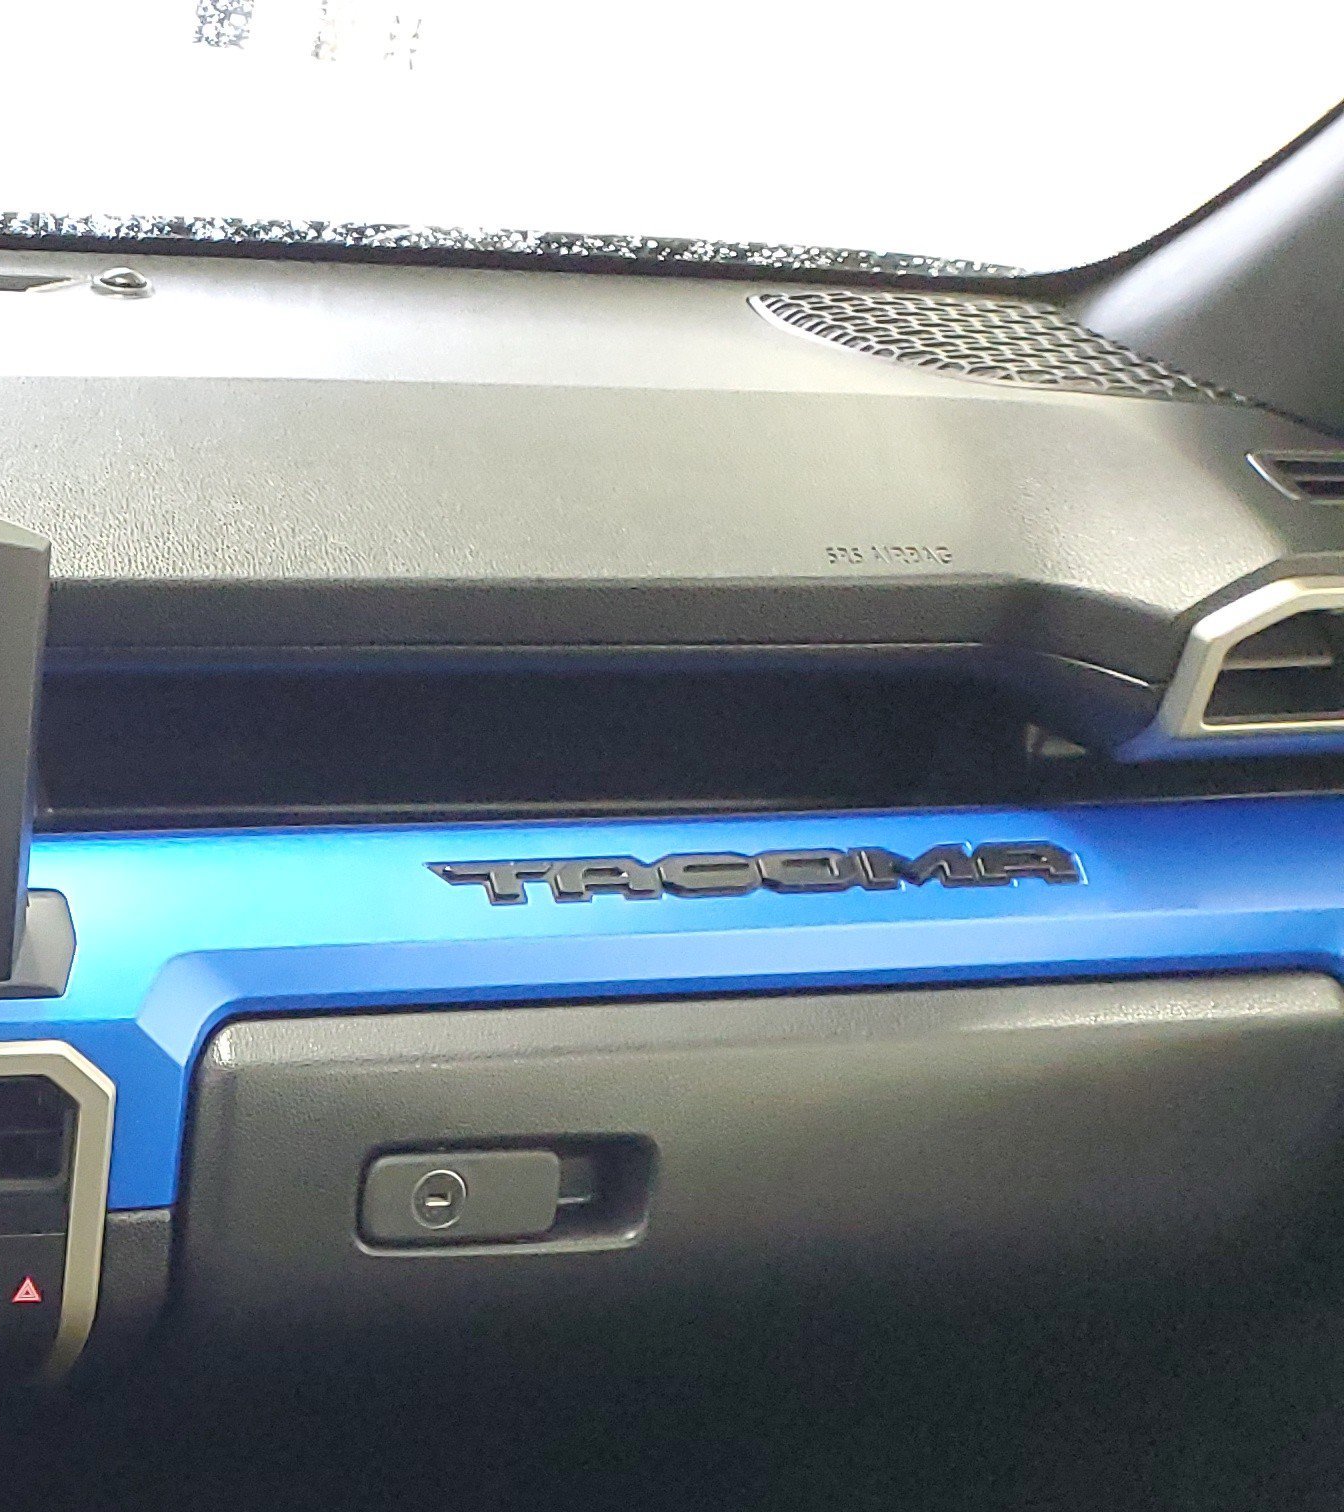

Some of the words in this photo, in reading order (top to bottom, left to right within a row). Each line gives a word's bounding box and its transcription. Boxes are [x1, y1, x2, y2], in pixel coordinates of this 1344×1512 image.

[826, 547, 863, 564] SRS
[871, 546, 953, 564] AIRBAG
[423, 840, 1088, 906] TACOMA
